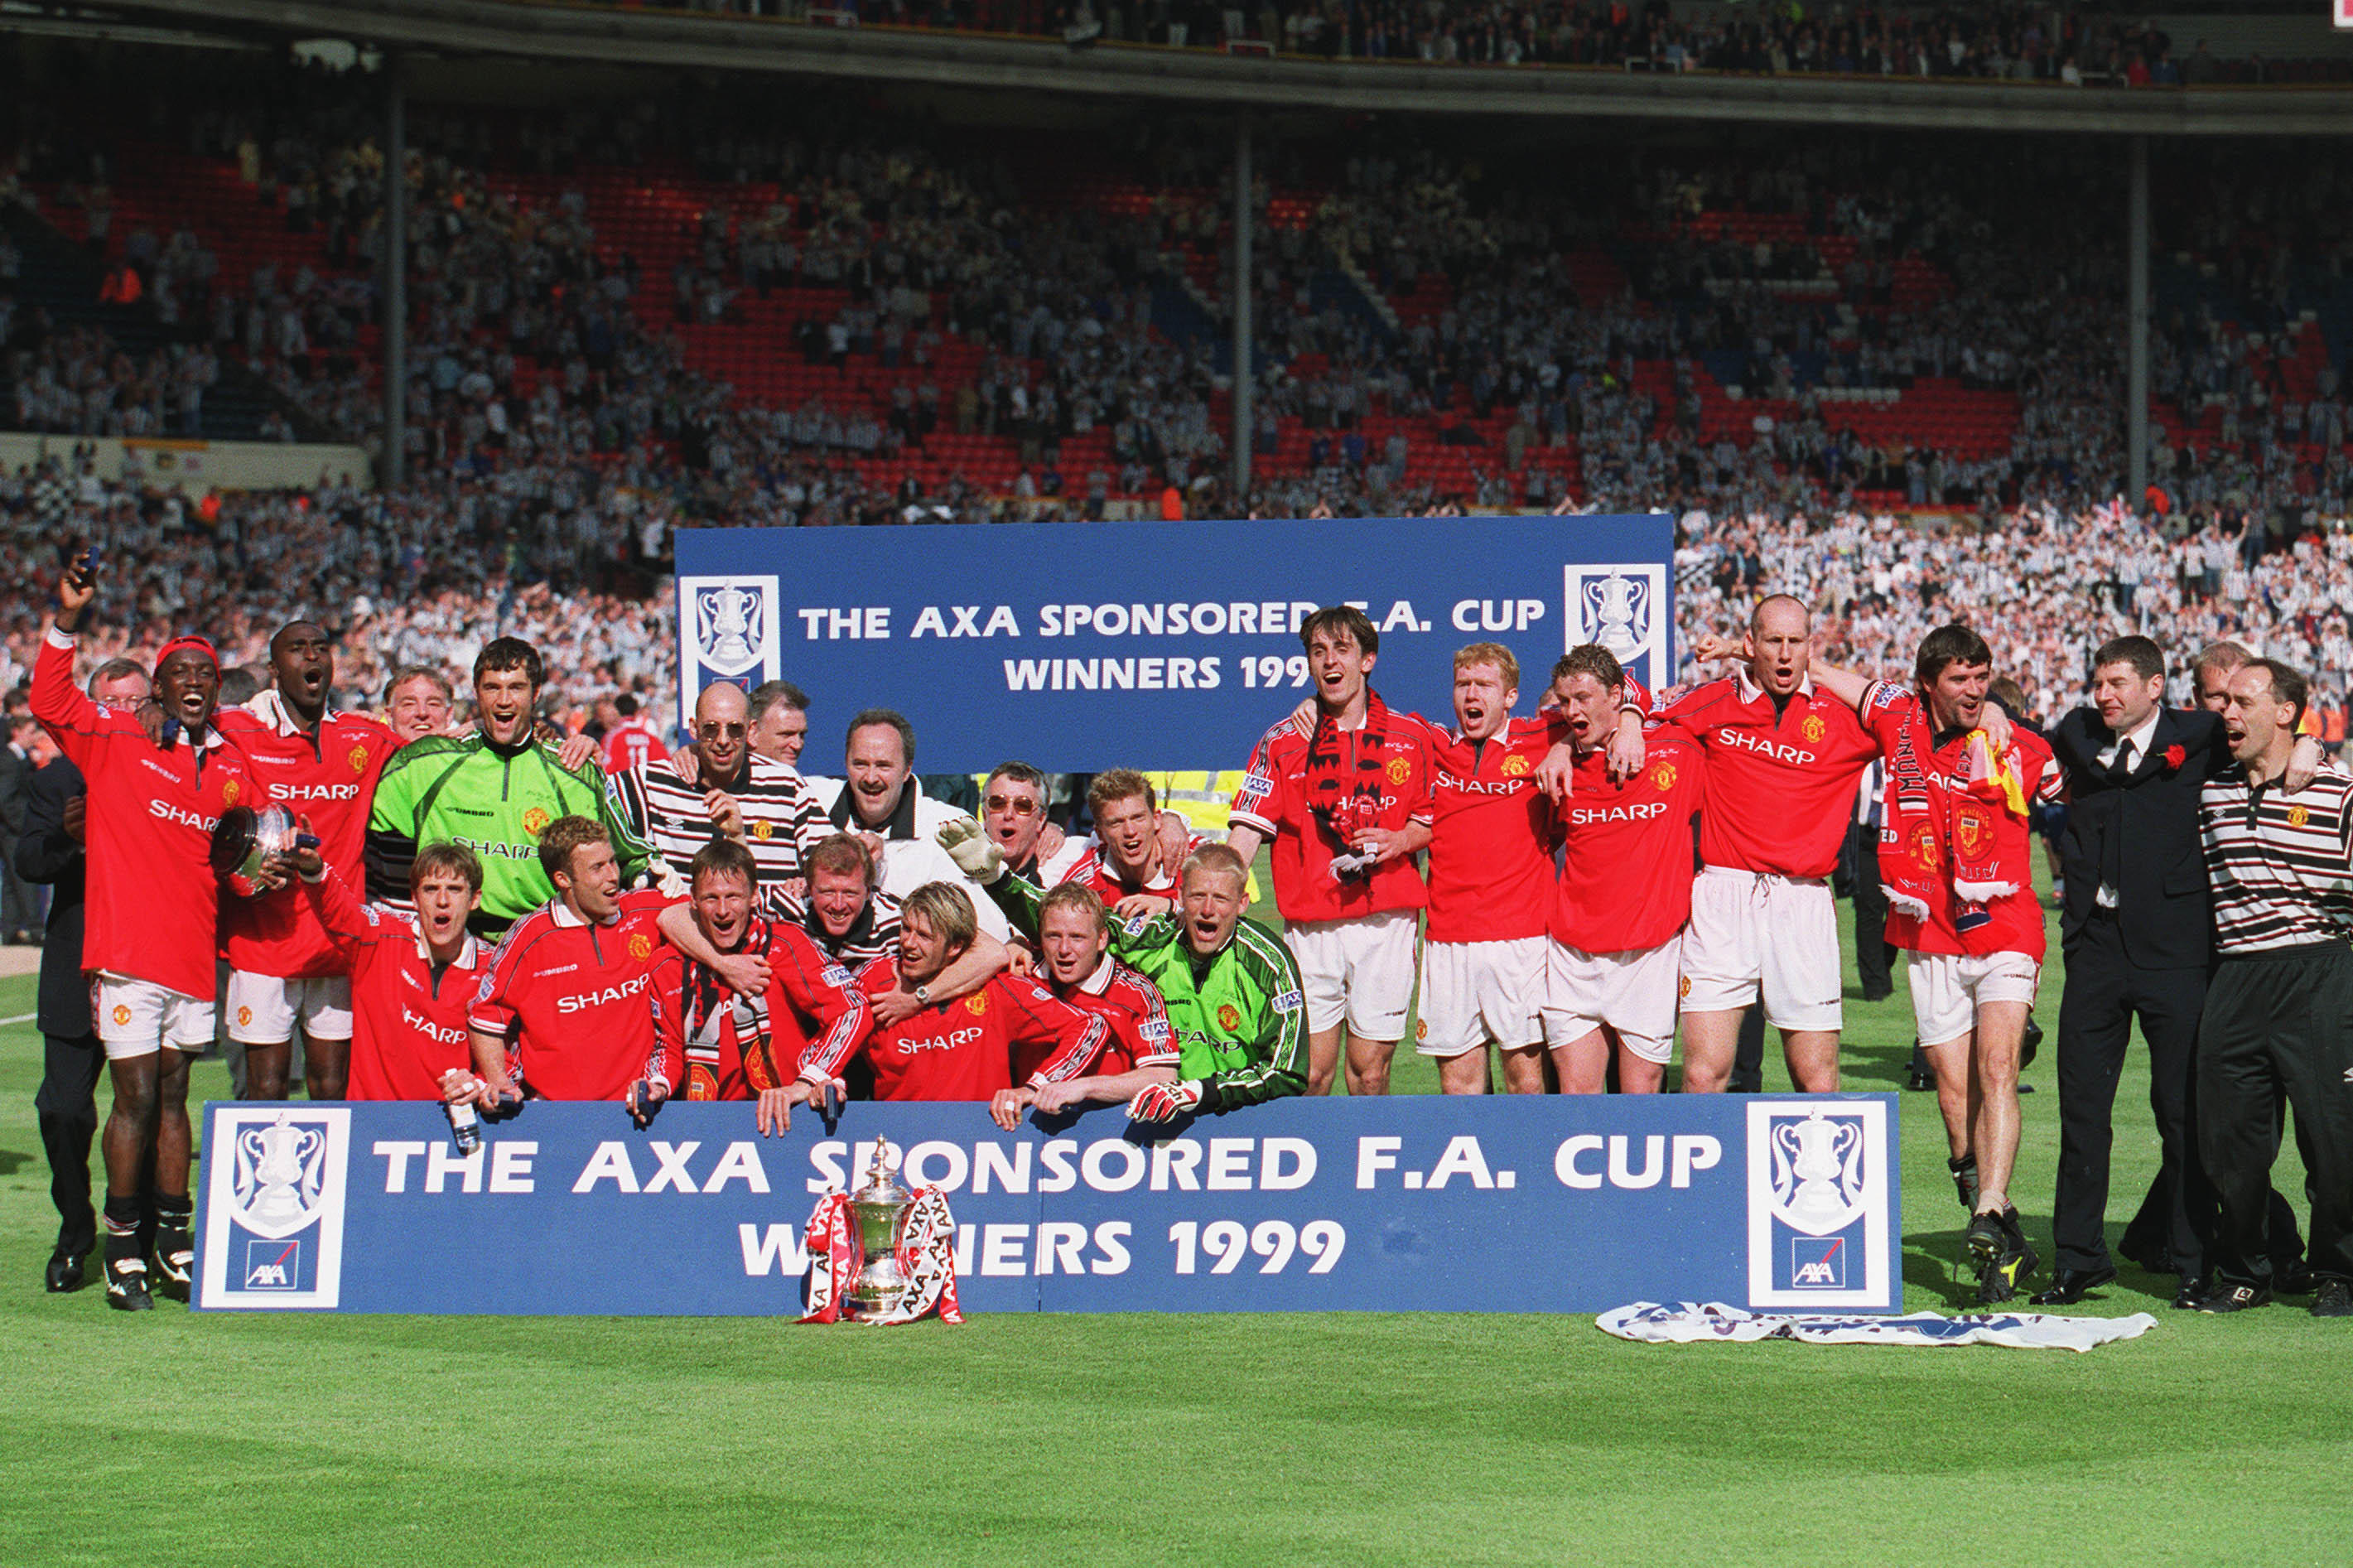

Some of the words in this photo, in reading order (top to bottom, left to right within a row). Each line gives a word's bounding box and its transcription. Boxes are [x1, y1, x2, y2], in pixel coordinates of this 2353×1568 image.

[798, 606, 891, 640] THE
[909, 605, 1020, 639] AXA
[1452, 598, 1545, 633] CUP
[1004, 655, 1222, 692] WINNERS
[1241, 655, 1310, 689] 199
[1718, 727, 1815, 765] SHARP
[268, 783, 359, 801] SHARP
[1435, 770, 1524, 795] SHARP
[149, 798, 222, 832] SHAR
[1571, 802, 1668, 825] SHARP
[556, 973, 651, 1014] SHARP
[403, 1004, 468, 1045] HARP
[897, 1027, 983, 1054] SHARP
[1174, 1026, 1242, 1055] HARP
[373, 1140, 539, 1194] THE
[571, 1141, 771, 1194] AXA
[807, 1136, 1319, 1195] SPONSORED
[1356, 1136, 1517, 1190] F.A.
[1555, 1134, 1723, 1190] CUP
[905, 1201, 929, 1240] AXA
[1169, 1219, 1347, 1276] 1999
[246, 1264, 288, 1285] AXA
[1793, 1262, 1836, 1283] AXA
[902, 1274, 929, 1315] AXA
